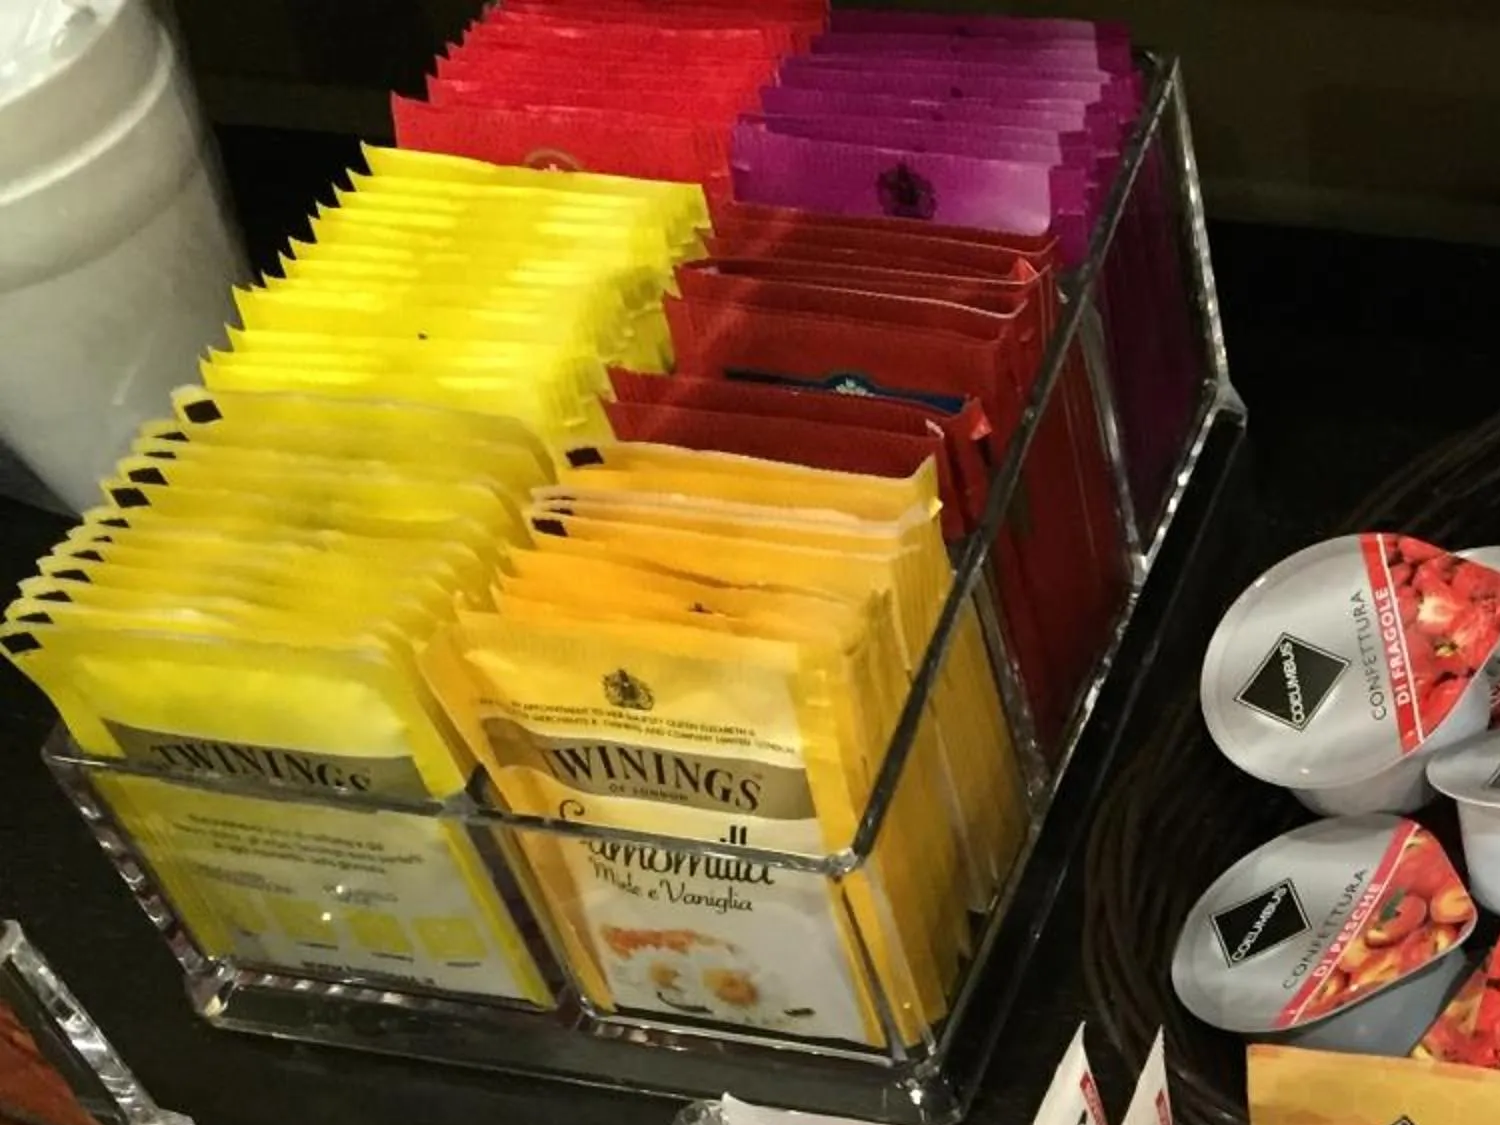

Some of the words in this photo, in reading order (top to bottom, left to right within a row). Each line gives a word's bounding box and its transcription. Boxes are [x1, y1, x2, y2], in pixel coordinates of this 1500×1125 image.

[1350, 590, 1388, 721] CONFETTURA
[1376, 588, 1405, 685] FRAGOLE
[1278, 641, 1306, 726] COLUMBUS
[659, 879, 755, 915] Vaniglia
